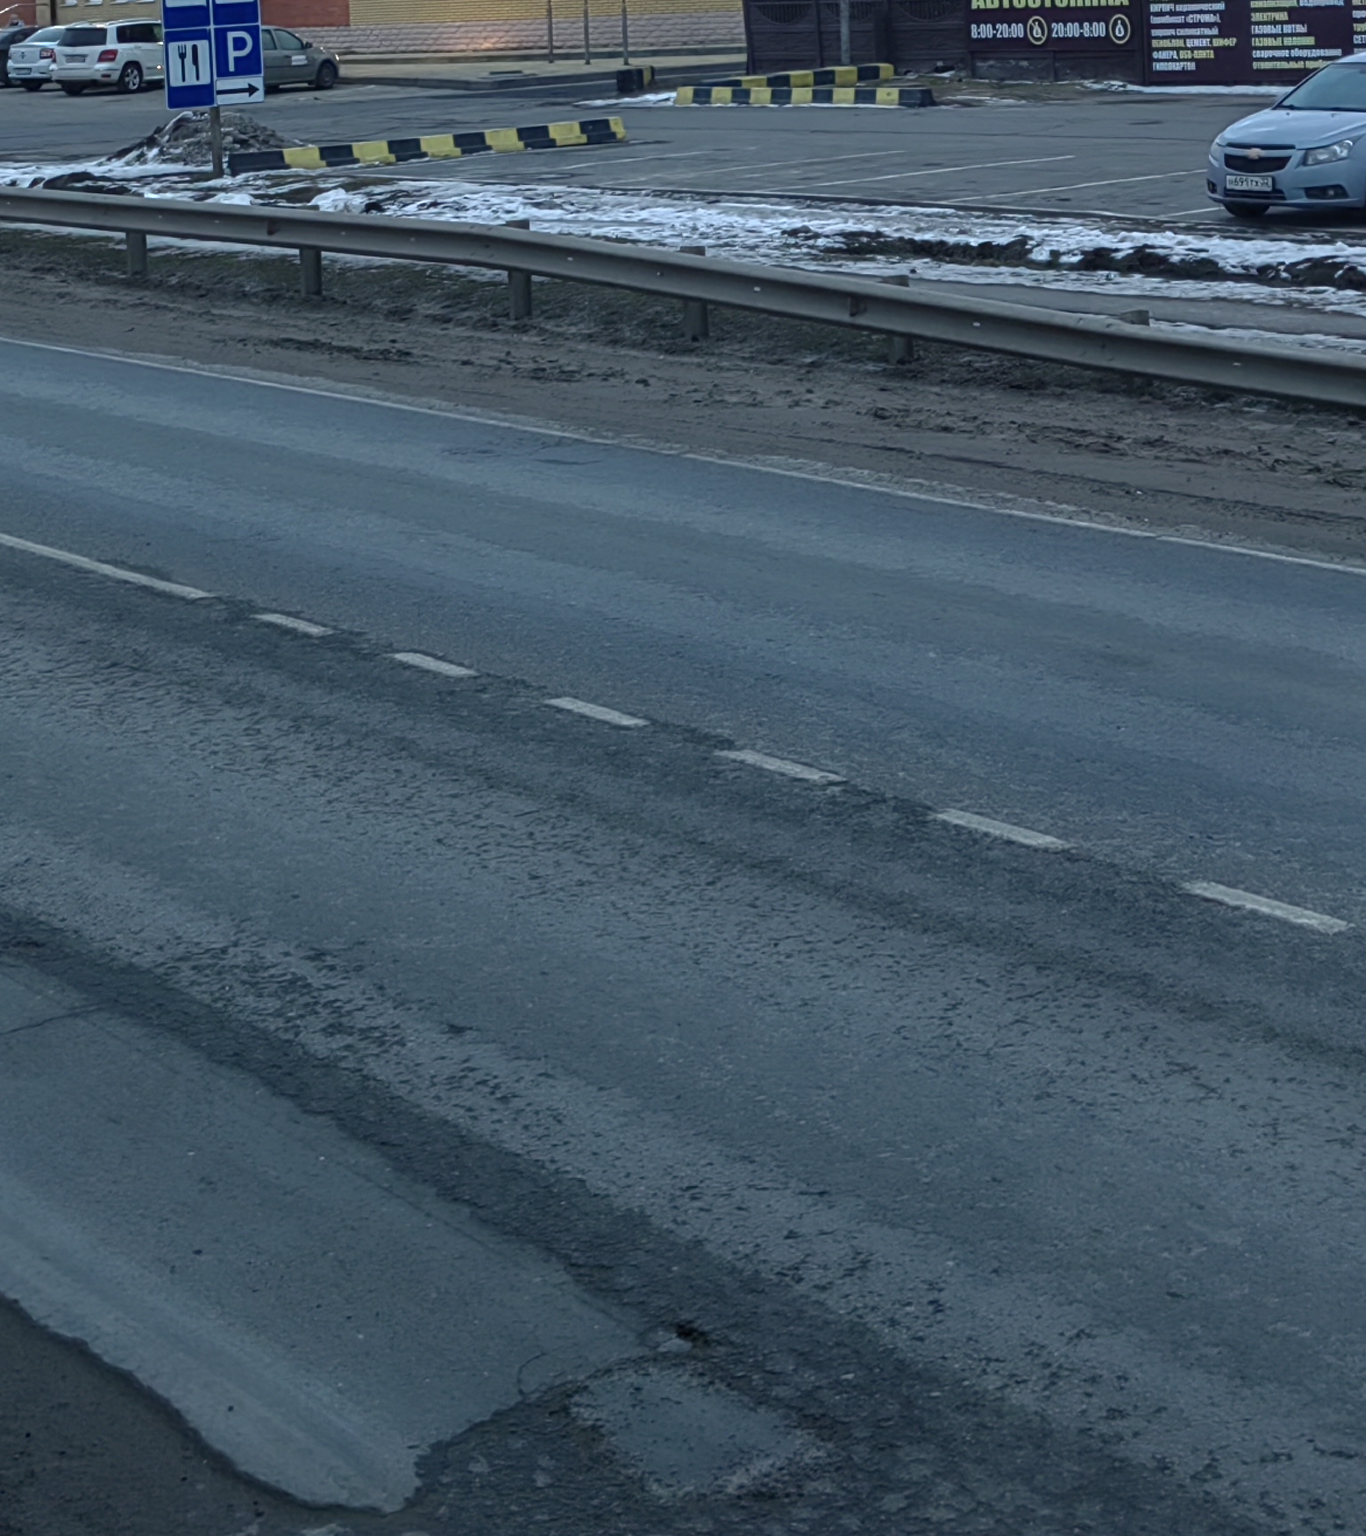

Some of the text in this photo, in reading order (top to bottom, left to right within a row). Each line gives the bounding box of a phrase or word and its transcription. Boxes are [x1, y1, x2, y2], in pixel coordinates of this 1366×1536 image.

[971, 22, 1106, 39] 8:00-20:00 20:00-8:00
[1252, 25, 1283, 35] ГАЗОВЫЕ
